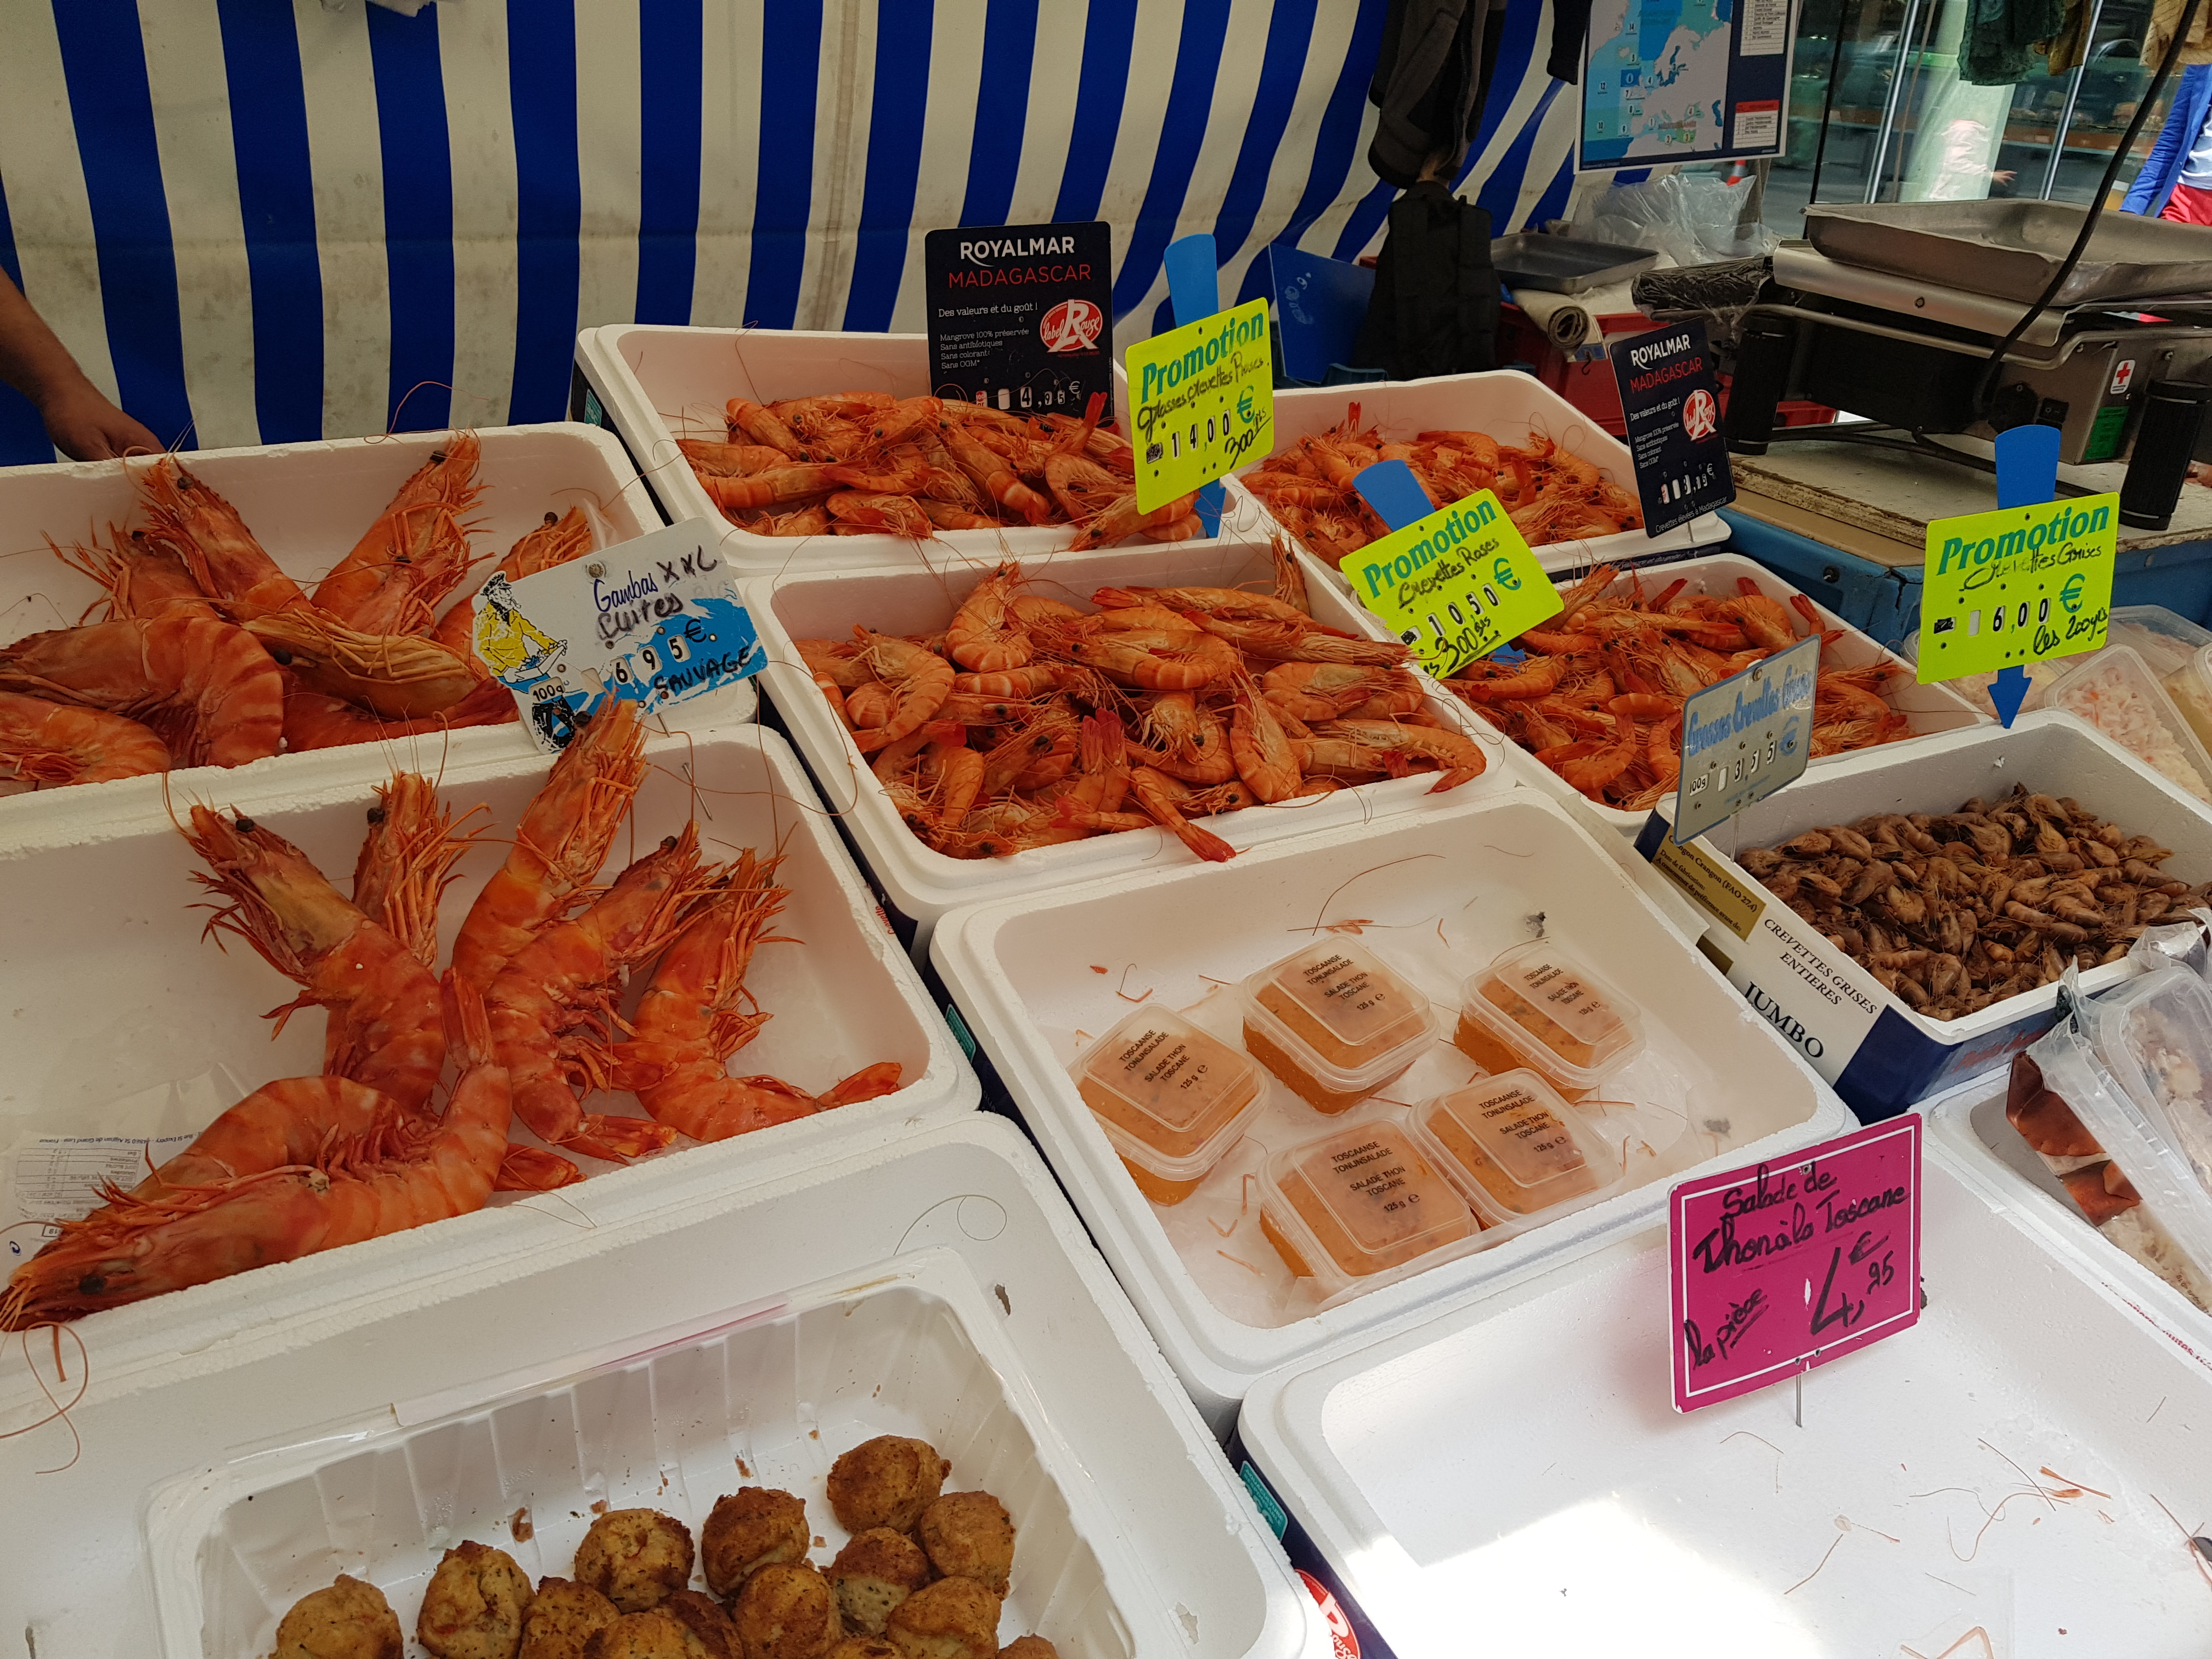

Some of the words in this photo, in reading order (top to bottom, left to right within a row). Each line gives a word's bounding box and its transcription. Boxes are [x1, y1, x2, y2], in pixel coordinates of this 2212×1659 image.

[960, 236, 1075, 267] ROYALMAR
[949, 264, 1091, 289] MADAGASCAR
[938, 307, 955, 318] Des
[956, 306, 988, 317] valeurs
[990, 306, 999, 314] et
[1001, 303, 1012, 313] du
[1014, 303, 1032, 315] goût
[940, 333, 975, 342] Mangrove
[995, 329, 1029, 338] préservée
[959, 340, 1003, 349] antibiotiques
[1141, 313, 1263, 404] Promotion
[1630, 334, 1691, 369] ROYALMAR
[1069, 381, 1080, 394] €
[1630, 357, 1703, 393] MADAGASCAR
[1237, 385, 1255, 424] €
[1630, 411, 1639, 421] Des
[1656, 518, 1678, 533] Crevettes
[1699, 496, 1728, 513] Madagascar
[1362, 500, 1497, 599] Promotion
[1936, 506, 2109, 576] Promotion
[594, 570, 658, 612] Gambas
[656, 545, 717, 584] XXL
[1493, 557, 1521, 591] €
[2059, 573, 2085, 613] €
[533, 684, 564, 702] 100g
[684, 619, 707, 642] €
[1435, 627, 1479, 673] 300
[1660, 849, 1673, 862] Date
[1668, 834, 1694, 861] Cngon
[1695, 857, 1722, 884] Crangon
[1722, 880, 1742, 899] (FAO
[1688, 883, 1695, 893] de
[1694, 889, 1719, 913] préférence
[1719, 911, 1733, 924] avant
[1303, 954, 1342, 977] TOSCAANSE
[1306, 958, 1353, 986] TONIJNSALADE
[1764, 918, 1833, 978] CREVETTES
[1832, 975, 1877, 1015] GRISES
[1779, 951, 1842, 1005] ENTIERES
[1324, 981, 1351, 998] SALADE
[1348, 972, 1368, 986] THON
[1339, 981, 1370, 1001] TOSCANE
[1357, 1001, 1369, 1011] 125
[1745, 981, 1824, 1058] JUMBO
[1119, 1029, 1156, 1063] TOSCAANSE
[1124, 1031, 1169, 1073] TONIJNSALADE
[1144, 1059, 1171, 1082] SALADE
[1168, 1043, 1187, 1063] THON
[1160, 1054, 1190, 1082] TOSCANE
[1180, 1078, 1193, 1090] 125
[1479, 1090, 1522, 1109] TOSCAANSE
[1481, 1096, 1535, 1119] TONIJNSALADE
[1499, 1119, 1530, 1135] SALADE
[1527, 1111, 1549, 1123] THON
[1515, 1122, 1550, 1139] TOSCANE
[1331, 1141, 1381, 1163] TOSCAANSE
[1333, 1148, 1393, 1175] TONIJNSALADE
[1533, 1143, 1548, 1153] 125
[1350, 1173, 1383, 1191] SALADE
[1383, 1165, 1406, 1179] THON
[1365, 1177, 1406, 1197] TOSCANE
[1722, 1164, 1798, 1216] Salade
[1804, 1161, 1837, 1191] de
[1383, 1201, 1399, 1213] 125
[1816, 1186, 1910, 1234] Toscane
[1685, 1319, 1716, 1370] la
